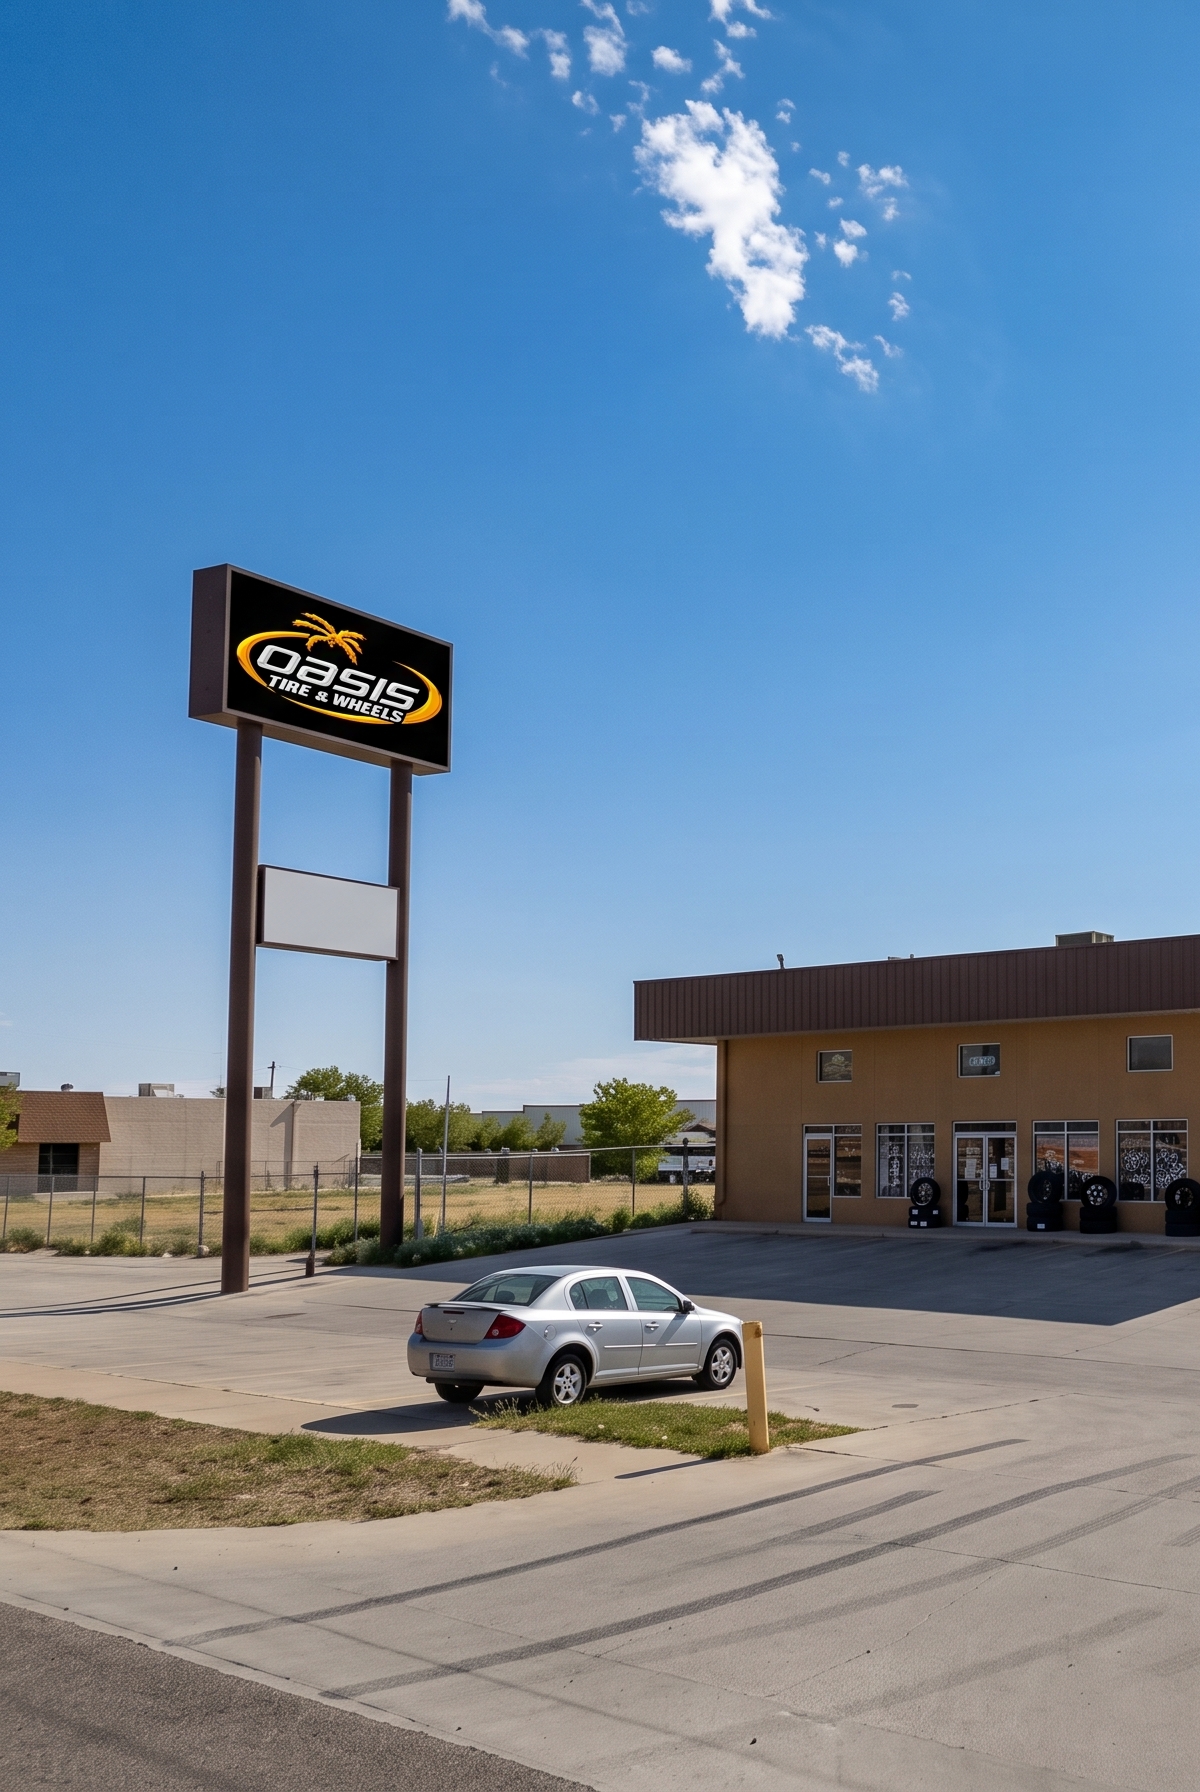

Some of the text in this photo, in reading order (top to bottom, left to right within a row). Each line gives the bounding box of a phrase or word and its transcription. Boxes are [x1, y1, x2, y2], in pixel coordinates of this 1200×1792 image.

[268, 674, 404, 723] TIRE & WHEELS
